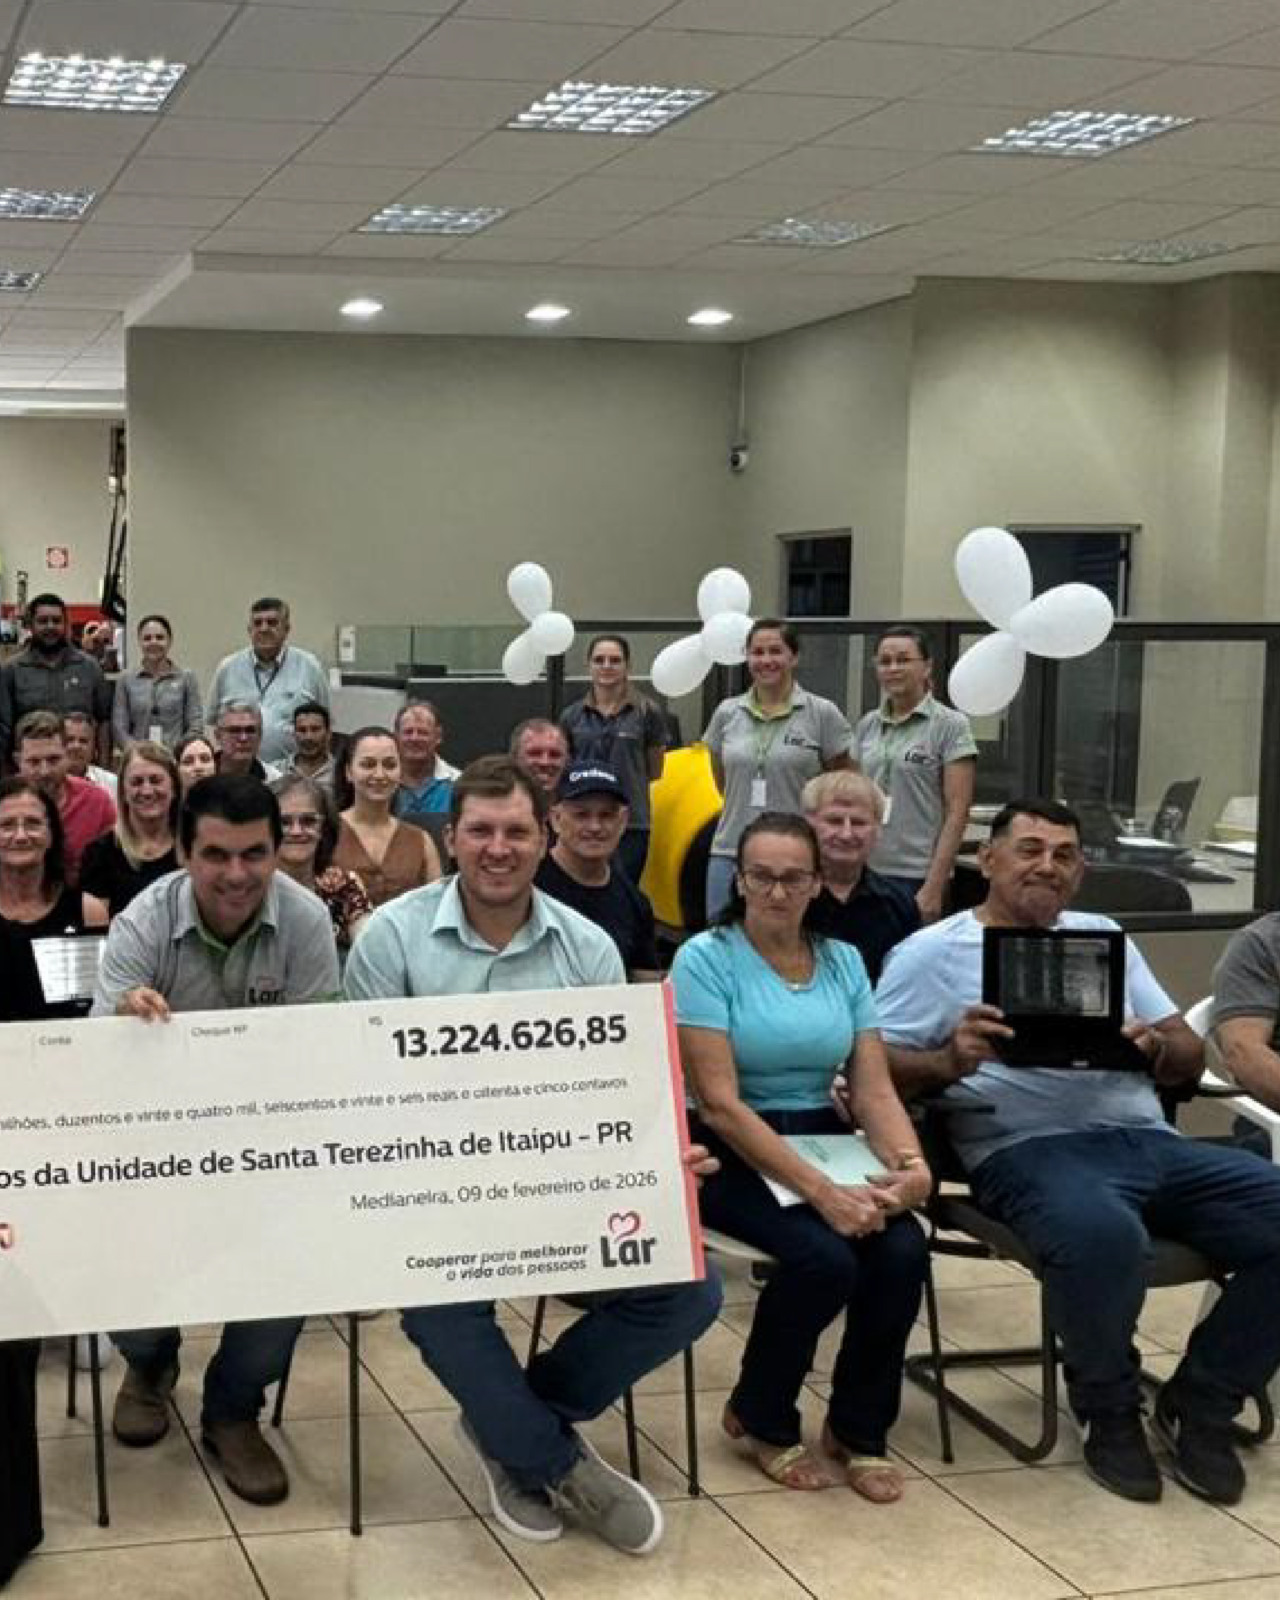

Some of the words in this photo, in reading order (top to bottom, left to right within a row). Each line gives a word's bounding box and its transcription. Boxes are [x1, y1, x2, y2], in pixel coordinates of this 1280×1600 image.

[248, 985, 282, 1004] Lar
[38, 1036, 72, 1046] Conta
[392, 1013, 627, 1058] 13.224.626,85
[54, 1113, 122, 1127] duzentos
[136, 1109, 172, 1123] vinte
[186, 1105, 233, 1120] quatro
[235, 1100, 262, 1116] mil,
[262, 1098, 338, 1115] seiscentos
[350, 1095, 384, 1108] vinte
[398, 1092, 425, 1105] seis
[426, 1090, 459, 1103] reais
[472, 1084, 522, 1100] oitenta
[532, 1082, 571, 1096] cinco
[569, 1078, 629, 1092] centavos
[33, 1162, 70, 1187] da
[77, 1154, 192, 1184] Unidade
[199, 1150, 235, 1176] de
[240, 1147, 320, 1172] Santa
[322, 1135, 454, 1165] Terezinha
[459, 1132, 492, 1156] de
[499, 1127, 572, 1154] Itaipu
[596, 1120, 633, 1145] PR
[349, 1190, 455, 1210] Medianeira,
[457, 1185, 483, 1203] 09
[486, 1183, 510, 1201] de
[512, 1179, 587, 1198] fevereiro
[589, 1175, 611, 1192] de
[615, 1169, 658, 1190] 2026
[405, 1254, 477, 1271] Cooperar
[480, 1251, 517, 1265] para
[520, 1244, 588, 1260] melhorar
[460, 1266, 494, 1280] vida
[495, 1263, 524, 1277] das
[525, 1258, 587, 1277] pessoas
[600, 1236, 657, 1269] Lar
